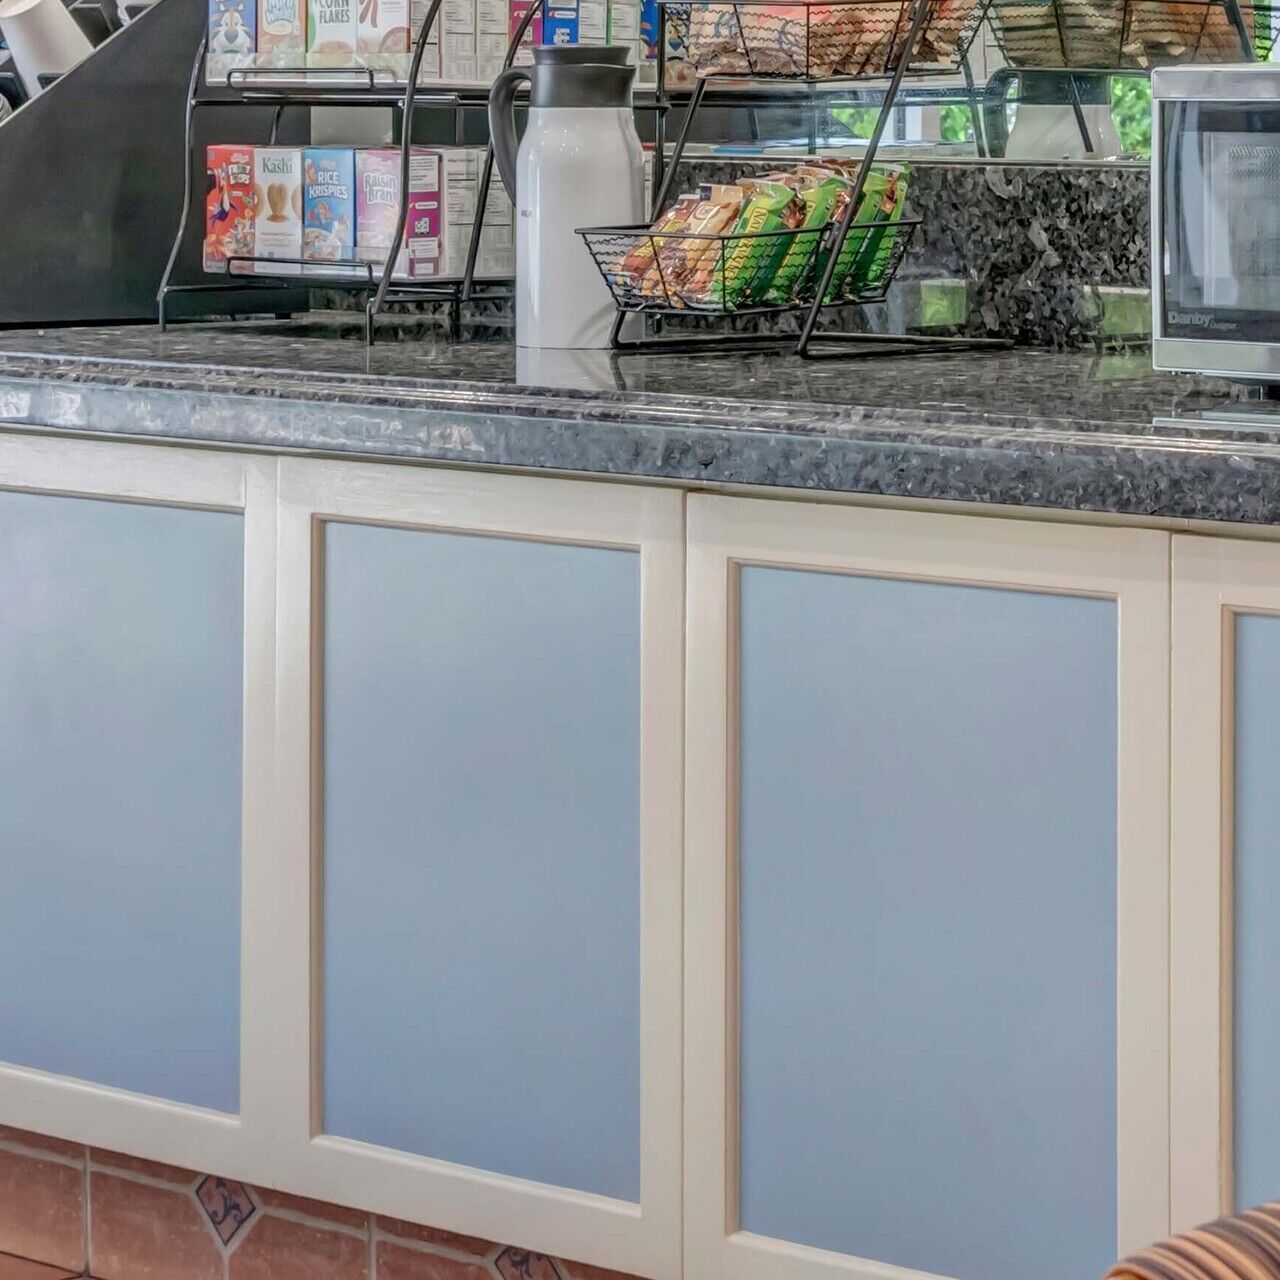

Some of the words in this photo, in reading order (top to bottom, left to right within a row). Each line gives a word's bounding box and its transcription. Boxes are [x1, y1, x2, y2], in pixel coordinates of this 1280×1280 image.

[320, 8, 350, 24] FLAKES
[262, 158, 294, 174] Kashi
[318, 172, 340, 184] RICE
[364, 172, 396, 191] Raisin
[309, 186, 348, 199] KRISPIES
[366, 189, 394, 204] Bran
[1168, 311, 1214, 327] Danby
